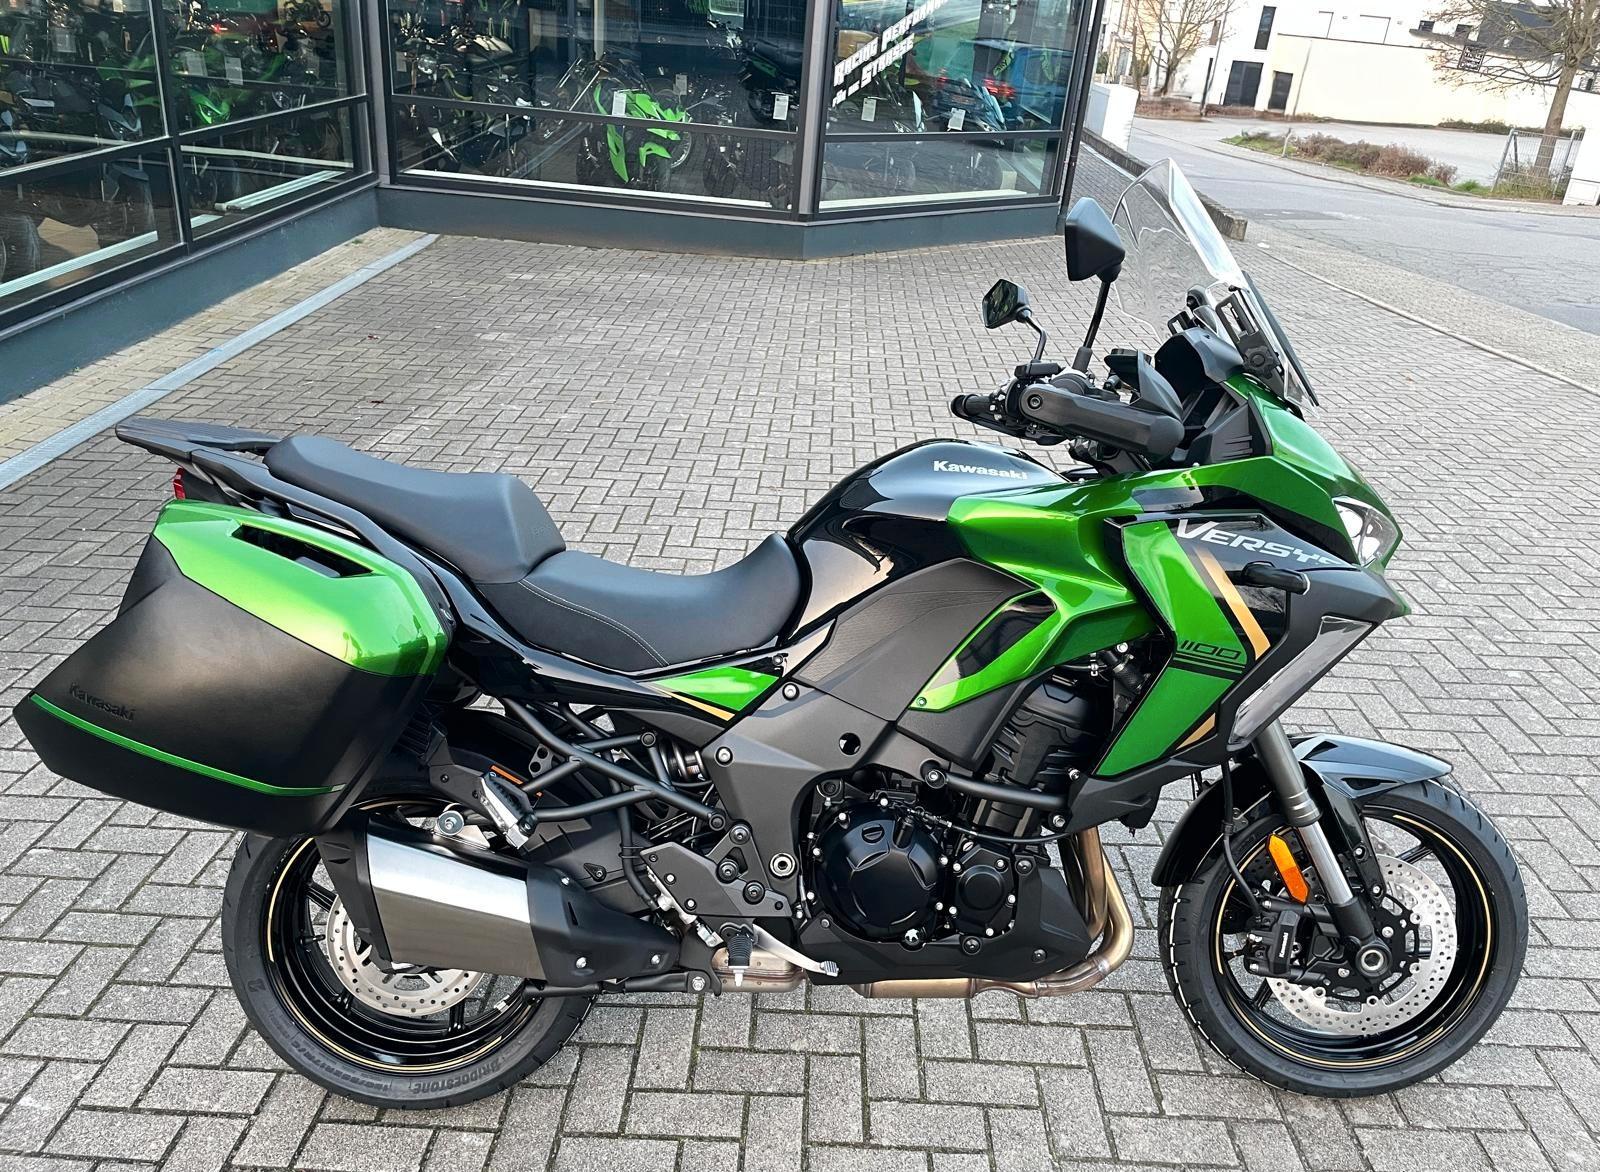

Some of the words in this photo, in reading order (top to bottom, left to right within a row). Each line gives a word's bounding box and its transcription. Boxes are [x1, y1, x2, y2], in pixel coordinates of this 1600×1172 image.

[933, 460, 1028, 480] Kawasaki
[1180, 640, 1241, 660] 1100
[69, 681, 137, 722] Kawasaki
[413, 1058, 502, 1094] BRIDGESTONE
